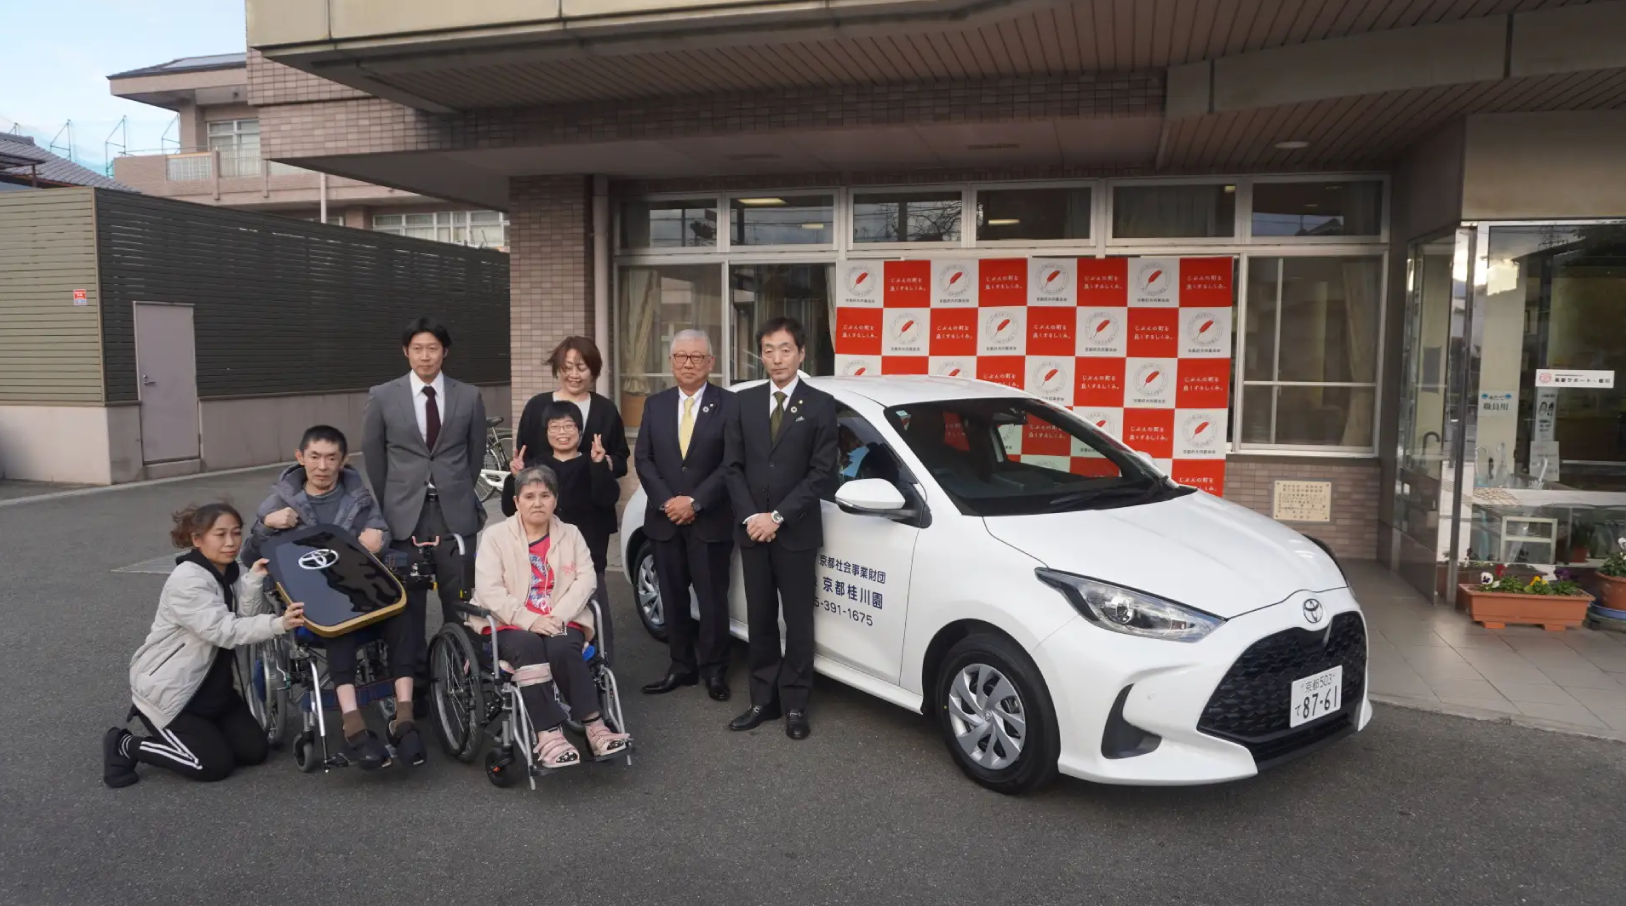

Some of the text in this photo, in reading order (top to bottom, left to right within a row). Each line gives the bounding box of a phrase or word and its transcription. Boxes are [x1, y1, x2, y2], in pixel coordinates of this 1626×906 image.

[820, 555, 886, 584] 京都社会事業財団
[823, 577, 882, 609] 京都桂川園
[1303, 685, 1337, 719] 87-61
